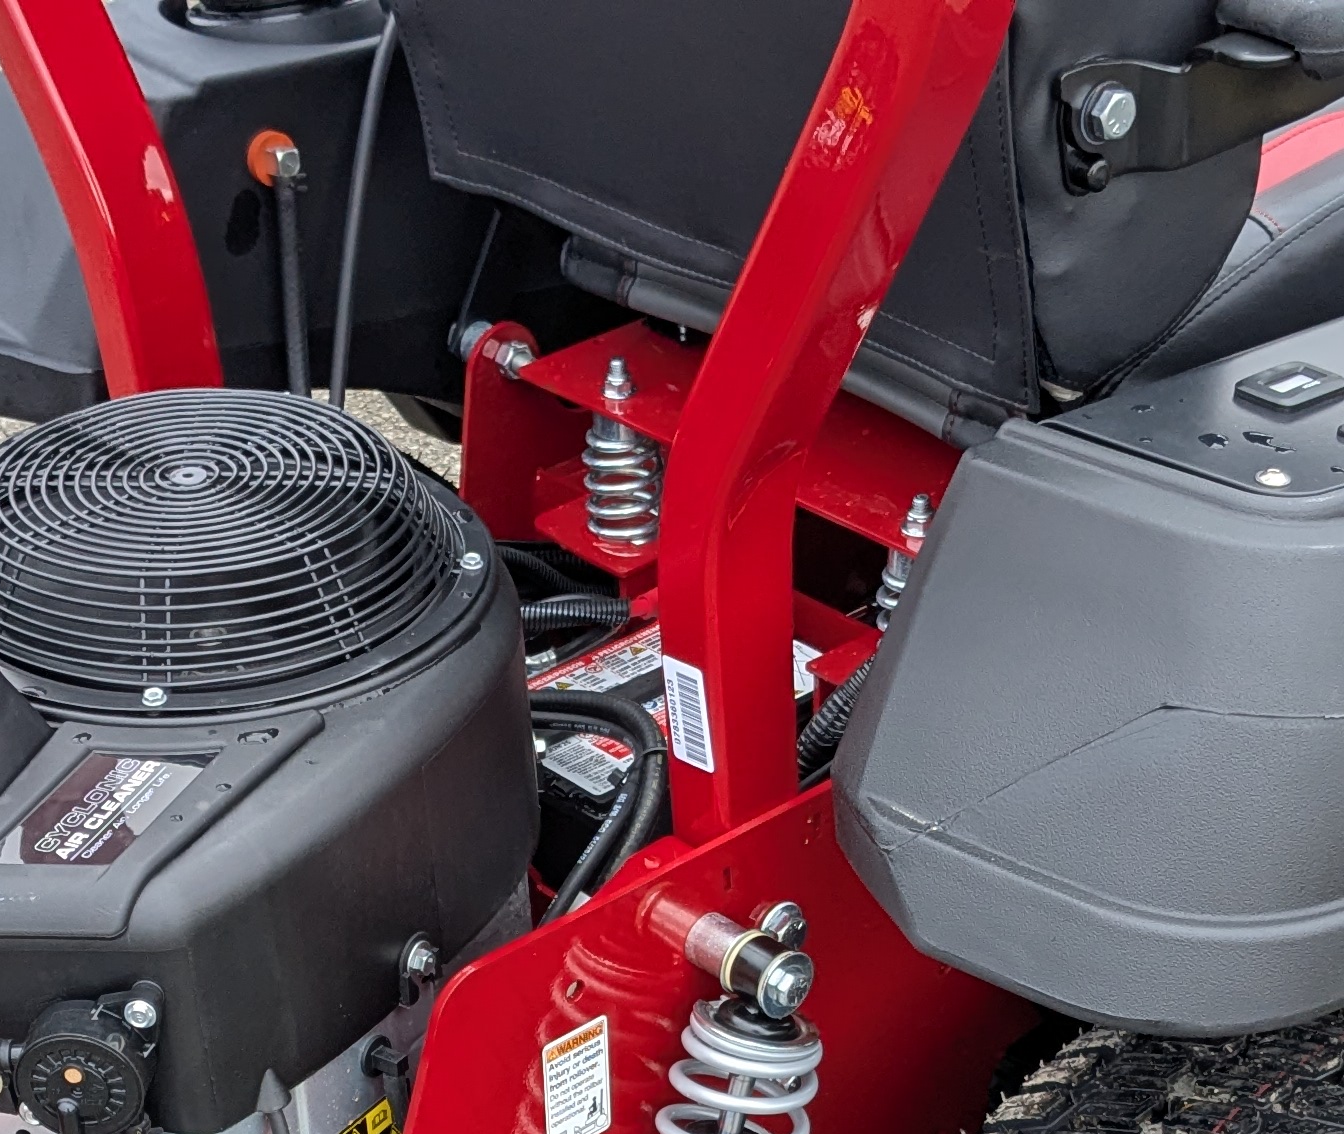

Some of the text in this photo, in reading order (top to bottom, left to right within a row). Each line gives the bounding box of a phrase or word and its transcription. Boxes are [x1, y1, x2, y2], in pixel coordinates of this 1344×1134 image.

[34, 758, 141, 853] CYCLONIC
[56, 760, 161, 860] AIR CLEANER
[126, 788, 155, 814] Longer
[556, 1024, 602, 1056] WARNING
[548, 1040, 601, 1072] Avoid serious
[549, 1049, 603, 1082] injury or death
[549, 1074, 594, 1102] Do not operate
[550, 1079, 567, 1092] from
[550, 1095, 572, 1111] without
[573, 1089, 583, 1098] the
[576, 1094, 589, 1105] and
